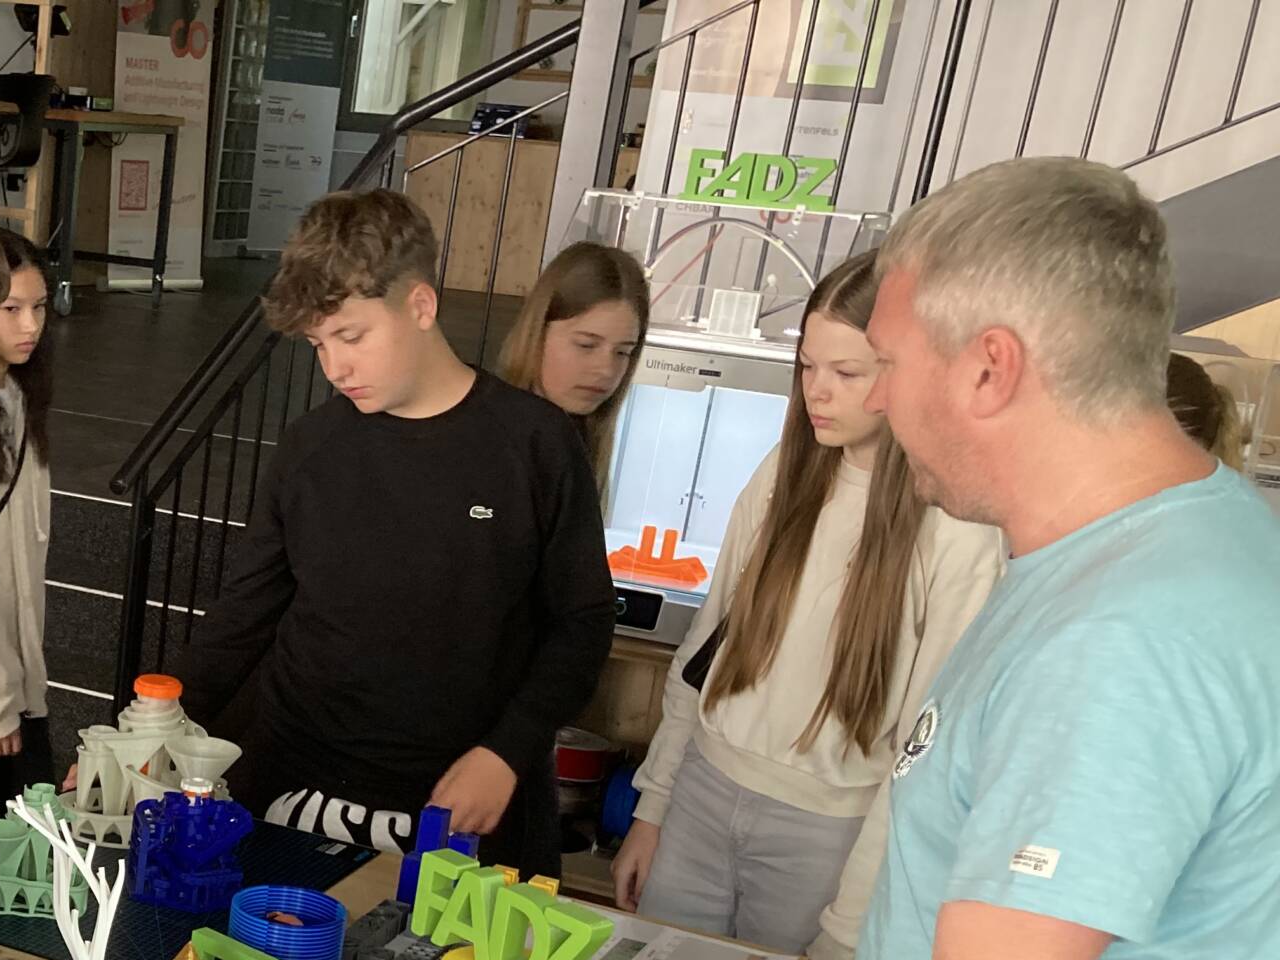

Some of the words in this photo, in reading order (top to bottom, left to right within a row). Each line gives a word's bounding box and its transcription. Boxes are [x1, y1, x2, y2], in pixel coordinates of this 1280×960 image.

[126, 57, 160, 71] MASTER
[682, 147, 839, 206] FADZ
[645, 358, 698, 375] Ultimaker
